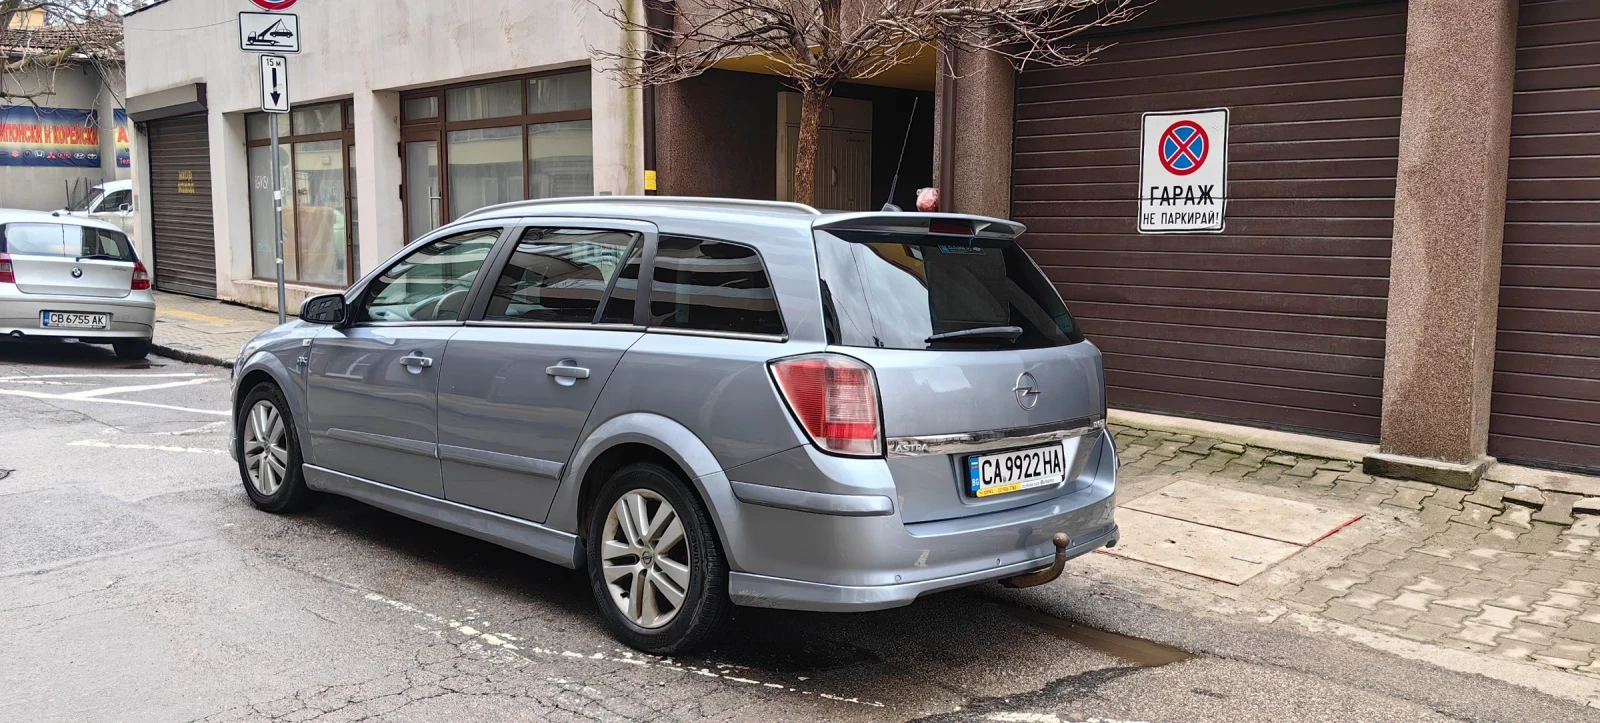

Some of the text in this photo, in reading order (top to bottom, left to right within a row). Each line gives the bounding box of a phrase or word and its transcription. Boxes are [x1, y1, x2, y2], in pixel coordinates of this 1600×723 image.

[266, 58, 274, 67] 15
[1150, 184, 1214, 206] ГАРАЖ
[1143, 211, 1219, 225] НЕ ПАРКИРАЙ!
[66, 314, 90, 324] 6755
[92, 315, 104, 325] AK
[894, 443, 929, 452] ASTRA
[982, 449, 1061, 485] CA 9922 HA
[971, 478, 980, 487] BG
